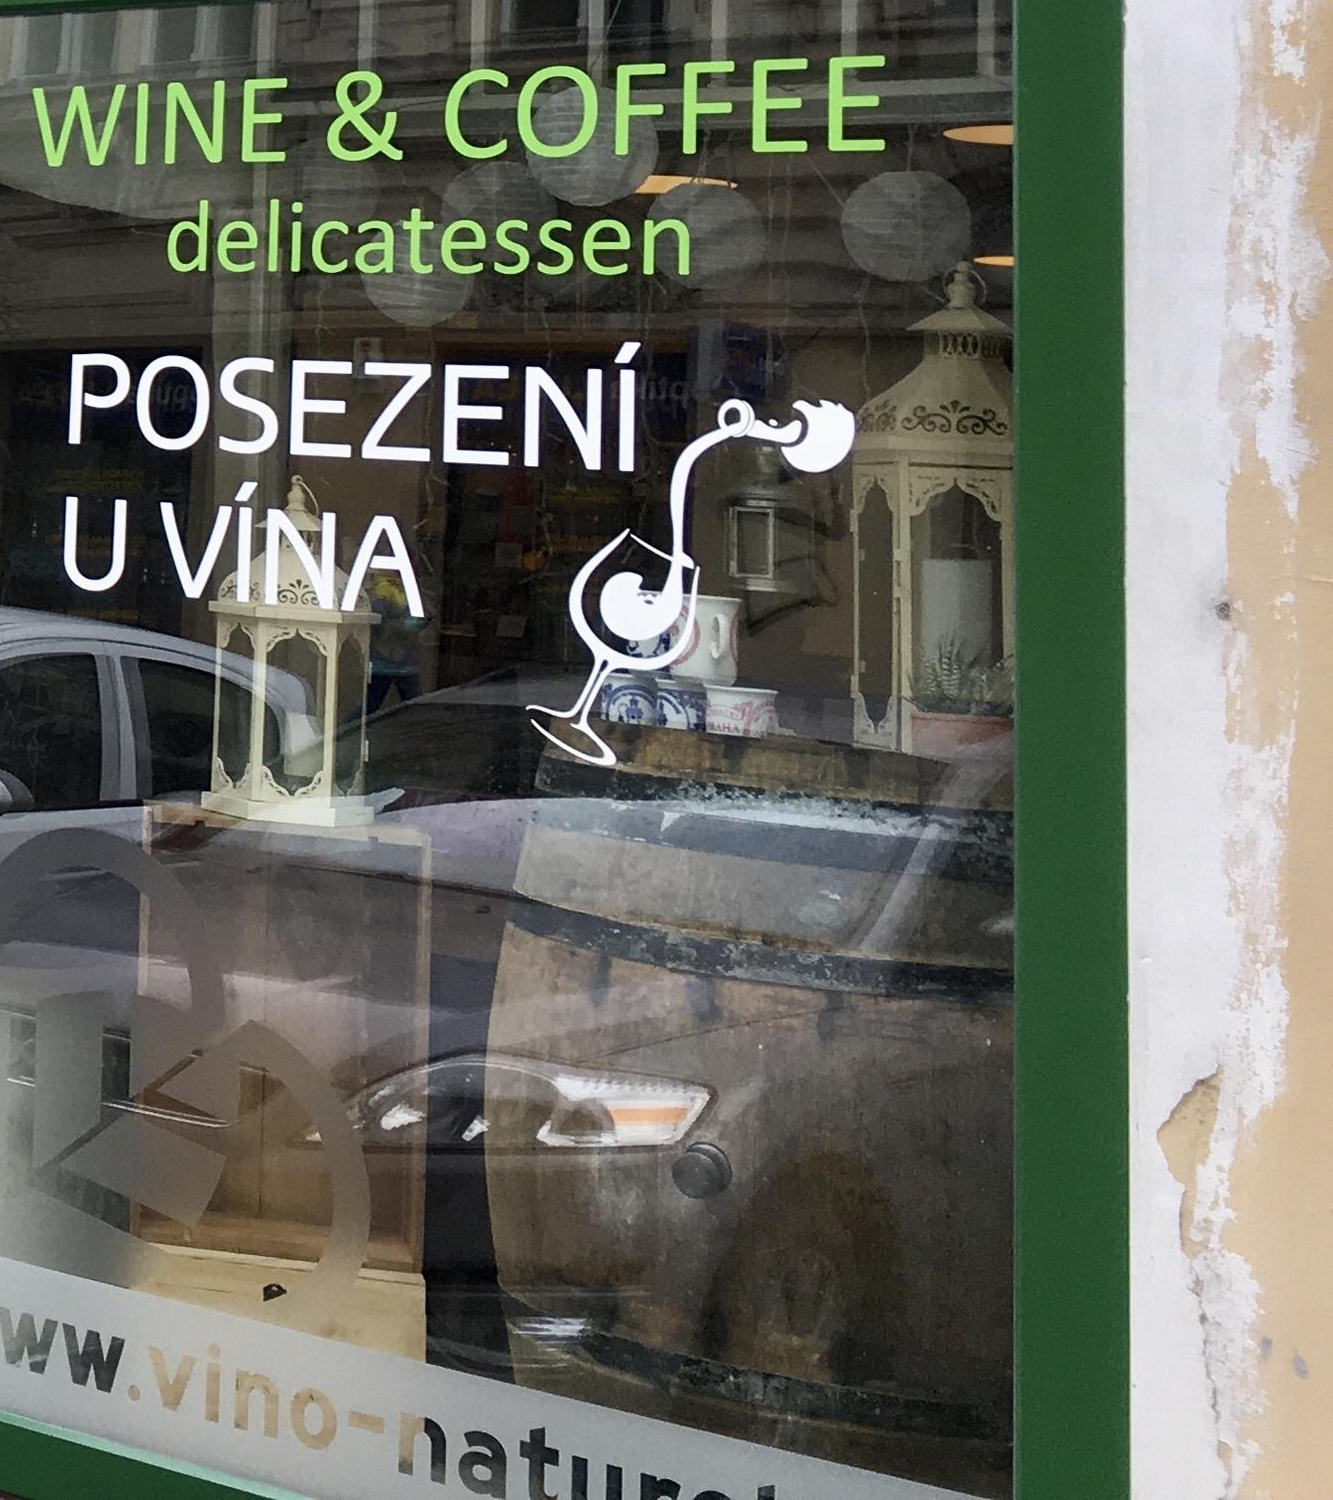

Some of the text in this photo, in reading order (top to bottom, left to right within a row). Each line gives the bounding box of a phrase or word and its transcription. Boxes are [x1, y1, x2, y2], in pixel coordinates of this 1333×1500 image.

[32, 54, 888, 168] WINE & COFFEE
[166, 199, 693, 277] delicatessen
[67, 340, 643, 473] POSEZENÍ
[64, 481, 426, 619] U VÍNA
